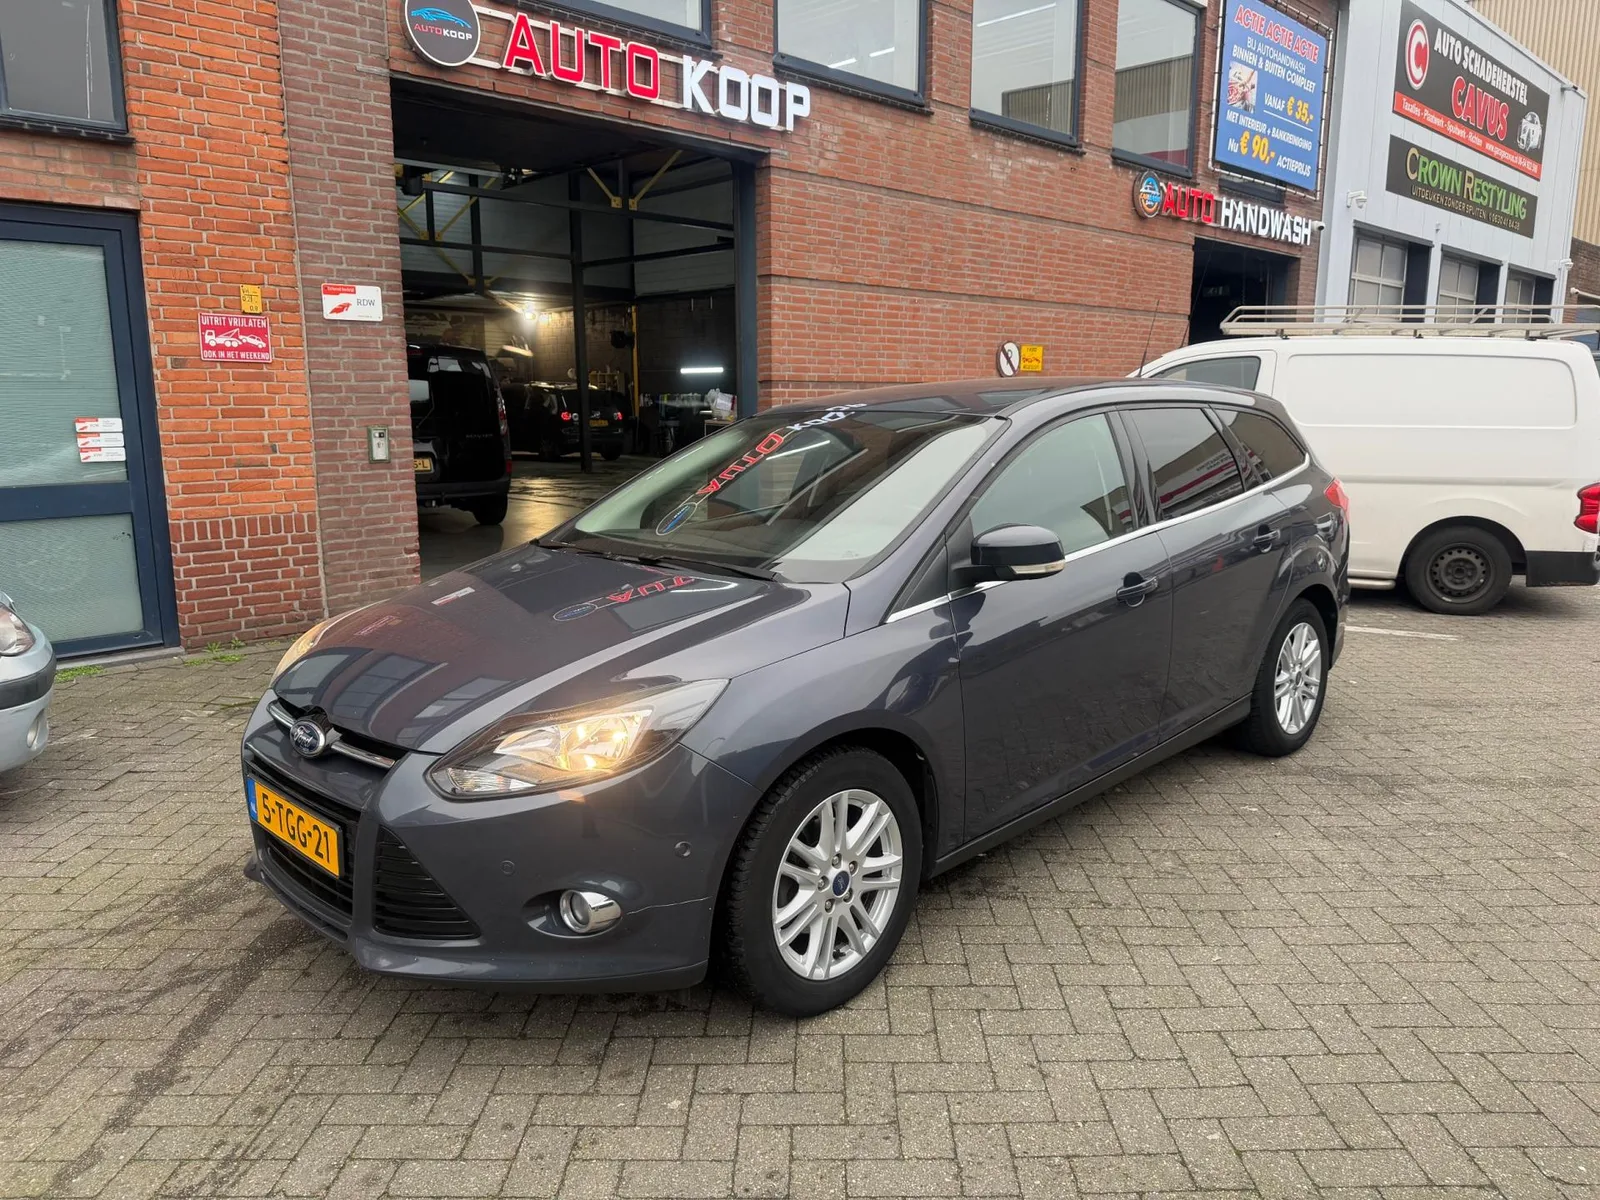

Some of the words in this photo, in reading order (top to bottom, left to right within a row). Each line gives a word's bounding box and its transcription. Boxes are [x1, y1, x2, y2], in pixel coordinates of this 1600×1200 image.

[414, 23, 472, 41] AUTOKOOP
[1234, 4, 1265, 36] ACTIE
[1264, 21, 1294, 50] ACTIE
[1293, 36, 1319, 63] ACTIE
[503, 13, 660, 100] AUTO
[683, 55, 811, 131] KOOP
[1232, 45, 1258, 67] BINNEN
[1264, 60, 1286, 79] BUITEN
[1286, 70, 1316, 94] COMPLEET
[1247, 36, 1256, 50] BIJ
[1257, 42, 1306, 74] AUTOHANDWASH
[1434, 28, 1462, 65] AUTO
[1462, 46, 1528, 106] SCHADEHERSTEL
[1264, 92, 1286, 111] VANAF
[1452, 76, 1510, 140] CAVUS
[1226, 110, 1239, 124] MET
[1239, 115, 1267, 134] INTERIEUR
[1272, 126, 1312, 152] BANKREINIGING
[1276, 155, 1312, 177] ACTIEPRIJS
[1406, 147, 1462, 196] CROWN
[1464, 170, 1527, 220] RESTYLING
[1162, 182, 1215, 224] AUTO
[1220, 197, 1312, 246] HANDWASH
[201, 316, 226, 326] UITRIT
[228, 318, 267, 328] VRIJLATEN
[356, 298, 376, 306] RDW
[204, 350, 217, 358] OOK
[218, 350, 225, 358] IN
[240, 352, 270, 360] WEEKEND
[262, 792, 330, 864] 5-TGG-21
